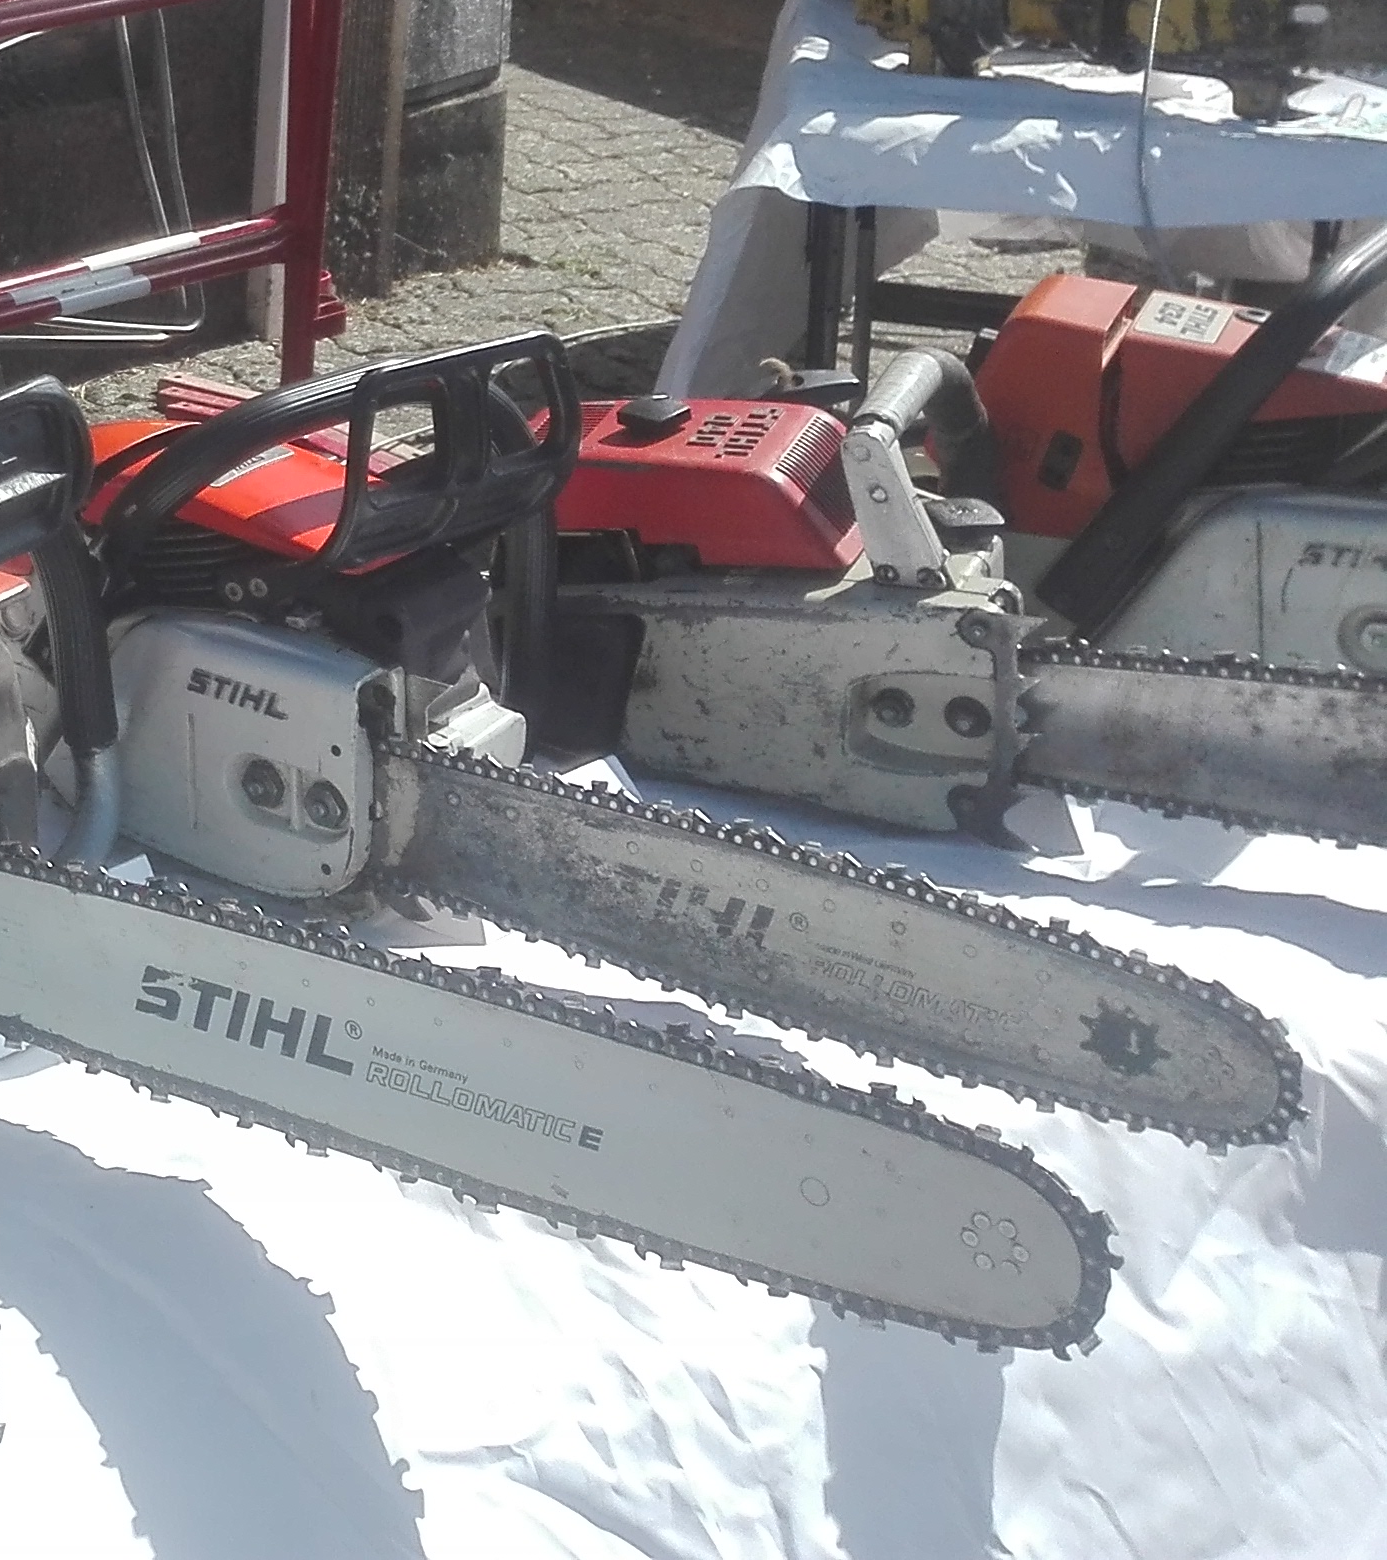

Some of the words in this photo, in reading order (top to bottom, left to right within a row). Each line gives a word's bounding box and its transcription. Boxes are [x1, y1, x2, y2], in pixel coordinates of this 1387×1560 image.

[187, 667, 289, 721] STIHL
[135, 965, 354, 1076] STIHL
[372, 1045, 402, 1063] Made
[406, 1055, 415, 1067] in
[418, 1060, 469, 1084] Germany
[366, 1061, 576, 1143] ROLLOMATIC
[578, 1125, 604, 1151] E
